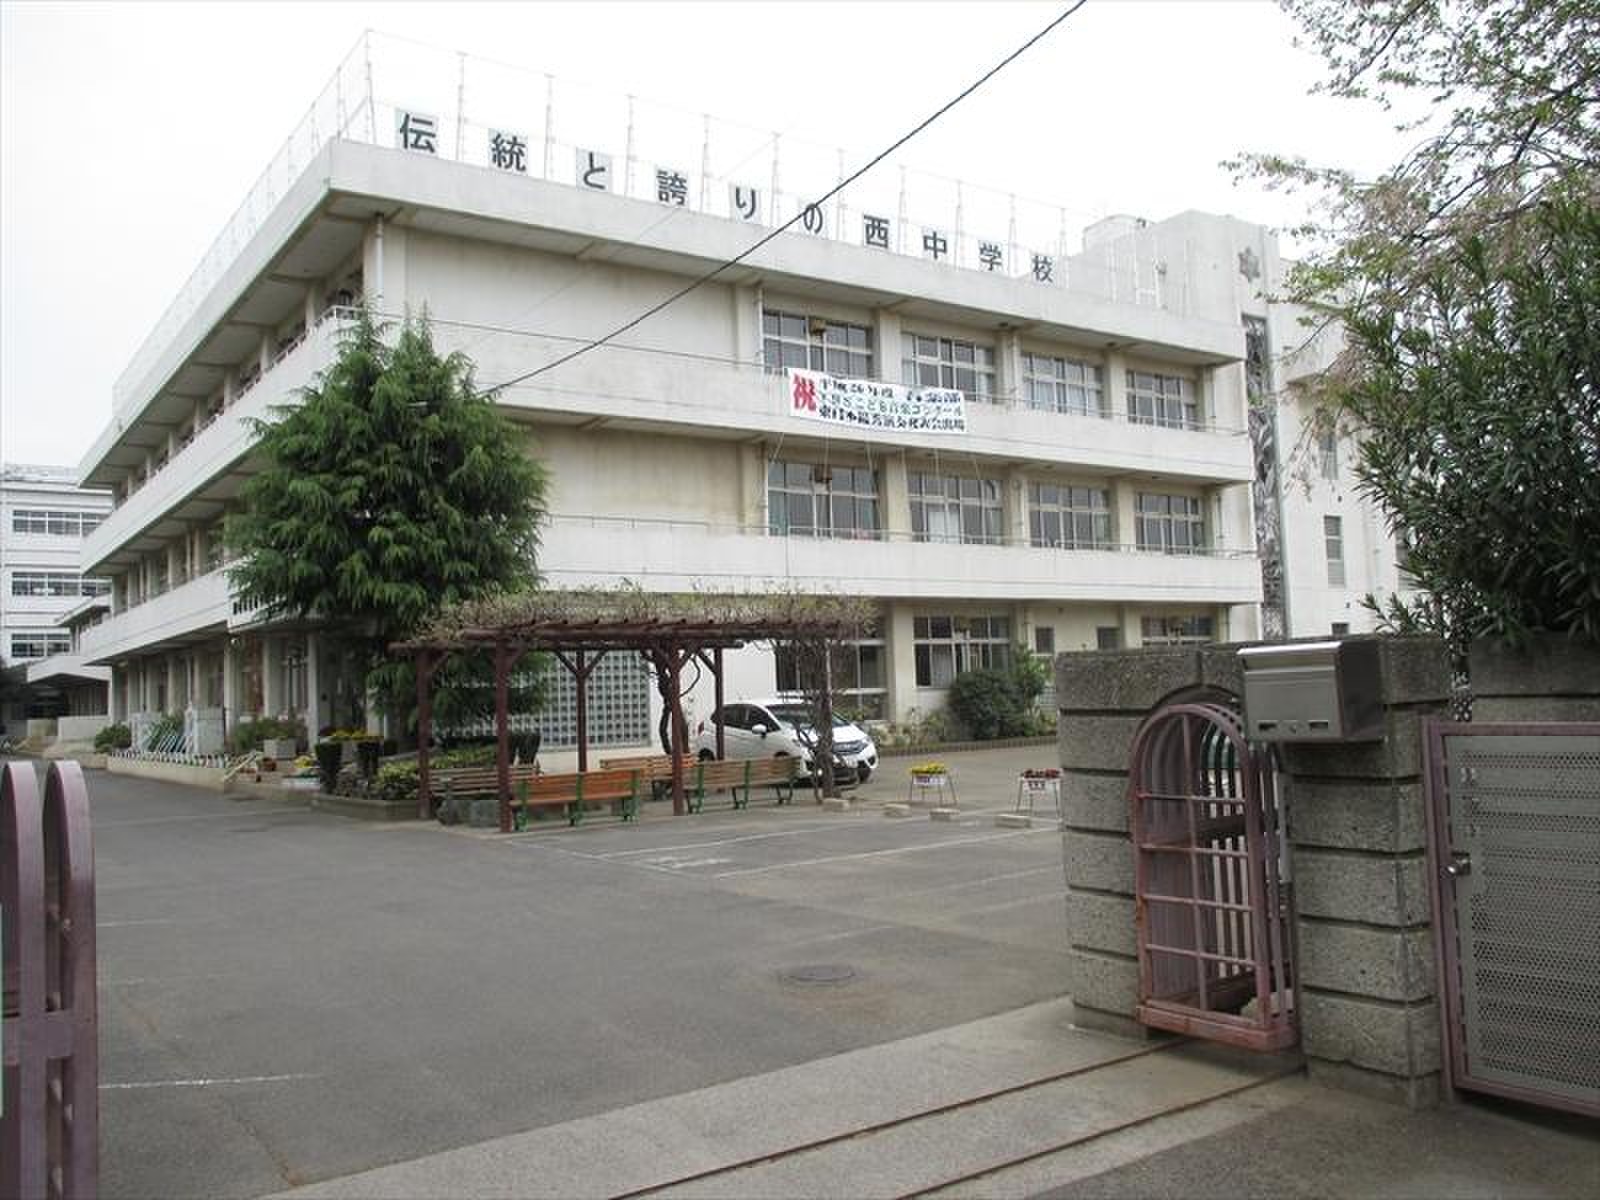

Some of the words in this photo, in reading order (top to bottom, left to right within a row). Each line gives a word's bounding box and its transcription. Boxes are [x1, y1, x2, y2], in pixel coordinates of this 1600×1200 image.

[399, 112, 1053, 282] 伝統と誇りの西中学校
[793, 374, 817, 411] 祝
